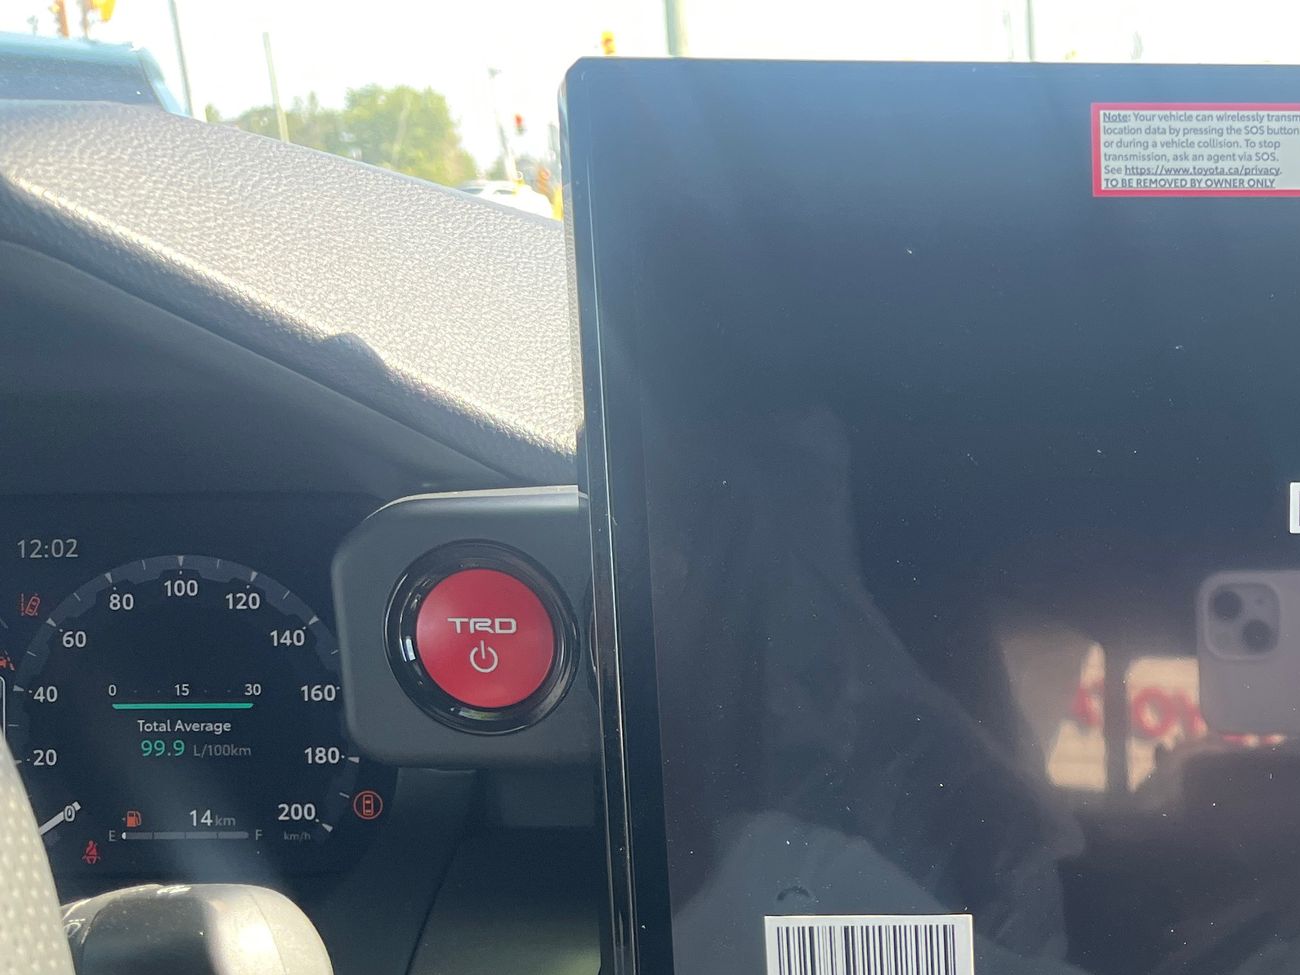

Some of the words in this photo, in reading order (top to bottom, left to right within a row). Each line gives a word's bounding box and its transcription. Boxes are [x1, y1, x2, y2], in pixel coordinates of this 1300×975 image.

[1102, 112, 1132, 123] Note:
[1133, 112, 1157, 122] Your
[1158, 112, 1193, 122] vehicle
[1195, 114, 1214, 122] can
[1216, 112, 1264, 124] wirelessly
[1103, 125, 1142, 135] location
[1144, 125, 1166, 135] data
[1168, 125, 1180, 137] by
[1182, 125, 1224, 137] pressing
[1226, 125, 1242, 135] the
[1244, 125, 1264, 135] SOS
[1266, 125, 1300, 135] button
[1116, 140, 1149, 150] during
[1160, 139, 1195, 148] vehicle
[1197, 139, 1242, 148] collision.
[1244, 139, 1256, 148] To
[1258, 140, 1280, 150] stop
[1104, 152, 1170, 163] transmission,
[1172, 152, 1190, 162] ask
[1192, 154, 1204, 162] an
[1206, 154, 1236, 163] agent
[1238, 152, 1252, 161] via
[1254, 152, 1280, 162] SOS.
[1104, 165, 1122, 175] See
[1124, 165, 1282, 176] https://www.toyota.ca/privacy.
[1103, 178, 1119, 189] TO
[1121, 178, 1133, 189] BE
[1136, 178, 1188, 189] REMOVED
[1190, 178, 1203, 189] BY
[1204, 178, 1245, 189] OWNER
[1247, 178, 1276, 189] ONLY
[17, 538, 79, 558] 12:02
[163, 580, 198, 597] 100
[109, 594, 134, 611] 80
[225, 593, 261, 610] 120
[448, 618, 517, 634] TRD
[62, 630, 87, 648] 60
[270, 629, 305, 647] 140
[33, 686, 58, 703] 40
[108, 684, 117, 696] 0
[174, 684, 190, 696] 15
[245, 684, 262, 696] 30
[300, 684, 336, 702] 160
[137, 719, 171, 732] Total
[174, 719, 232, 735] Average
[140, 740, 186, 757] 99.9
[193, 744, 252, 758] L/100km
[304, 747, 340, 764] 180
[33, 749, 58, 766] 20
[63, 804, 76, 822] 0
[189, 810, 213, 827] 14
[215, 814, 236, 827] km
[278, 803, 316, 820] 200
[108, 830, 116, 842] E
[255, 829, 263, 840] F
[284, 831, 311, 842] km/h
